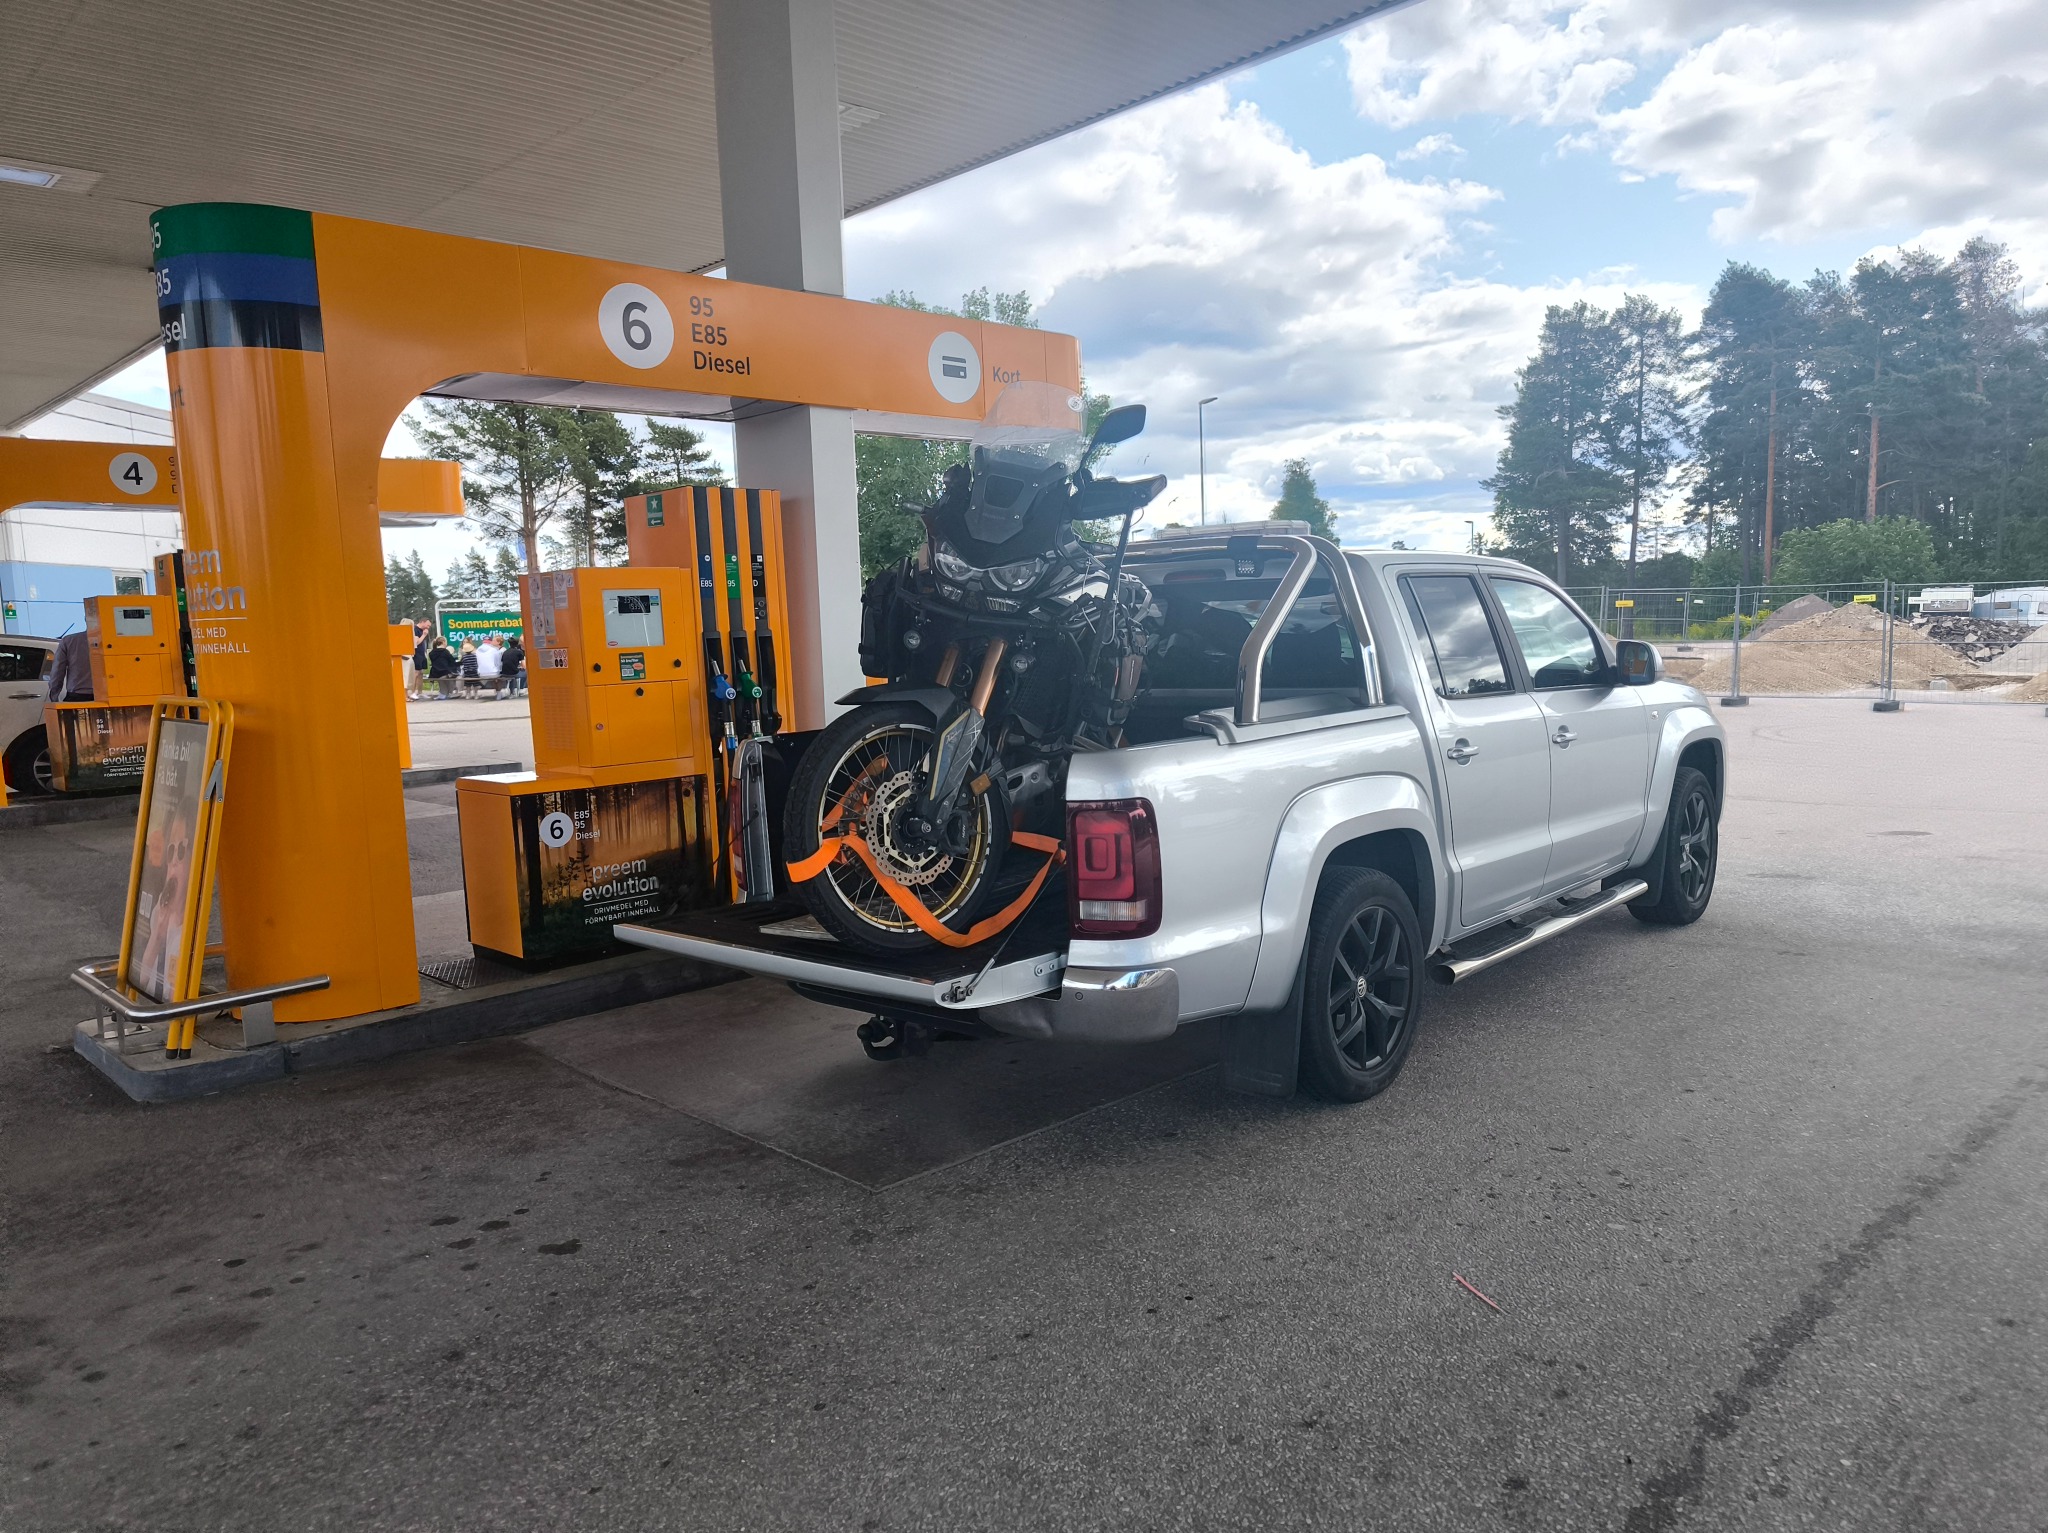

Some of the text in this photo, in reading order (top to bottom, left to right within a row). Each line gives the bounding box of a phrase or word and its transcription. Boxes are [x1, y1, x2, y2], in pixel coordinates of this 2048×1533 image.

[155, 267, 171, 298] 85
[689, 295, 714, 318] 95
[161, 312, 187, 345] esel
[622, 301, 652, 351] 6
[691, 322, 727, 346] E85
[693, 350, 751, 376] Diesel
[992, 366, 1021, 384] Kort
[123, 461, 143, 486] 4
[700, 580, 713, 588] E85
[727, 580, 736, 588] 95
[187, 581, 247, 612] ution
[206, 626, 227, 638] MED
[448, 617, 523, 630] Sommarrabat
[449, 631, 465, 642] 50
[200, 641, 250, 654] INNEHÅLL
[102, 753, 145, 765] evolutio
[108, 745, 145, 756] preem
[160, 739, 180, 760] Tanka
[573, 810, 590, 820] E85
[574, 820, 586, 829] 95
[550, 819, 564, 840] 6
[575, 829, 600, 841] Diesel
[592, 859, 647, 883] preem
[582, 876, 660, 901] evolution
[584, 905, 661, 925] FÖRNYBART INNEHÅLL
[594, 899, 649, 915] DRIVMEDEL MED
